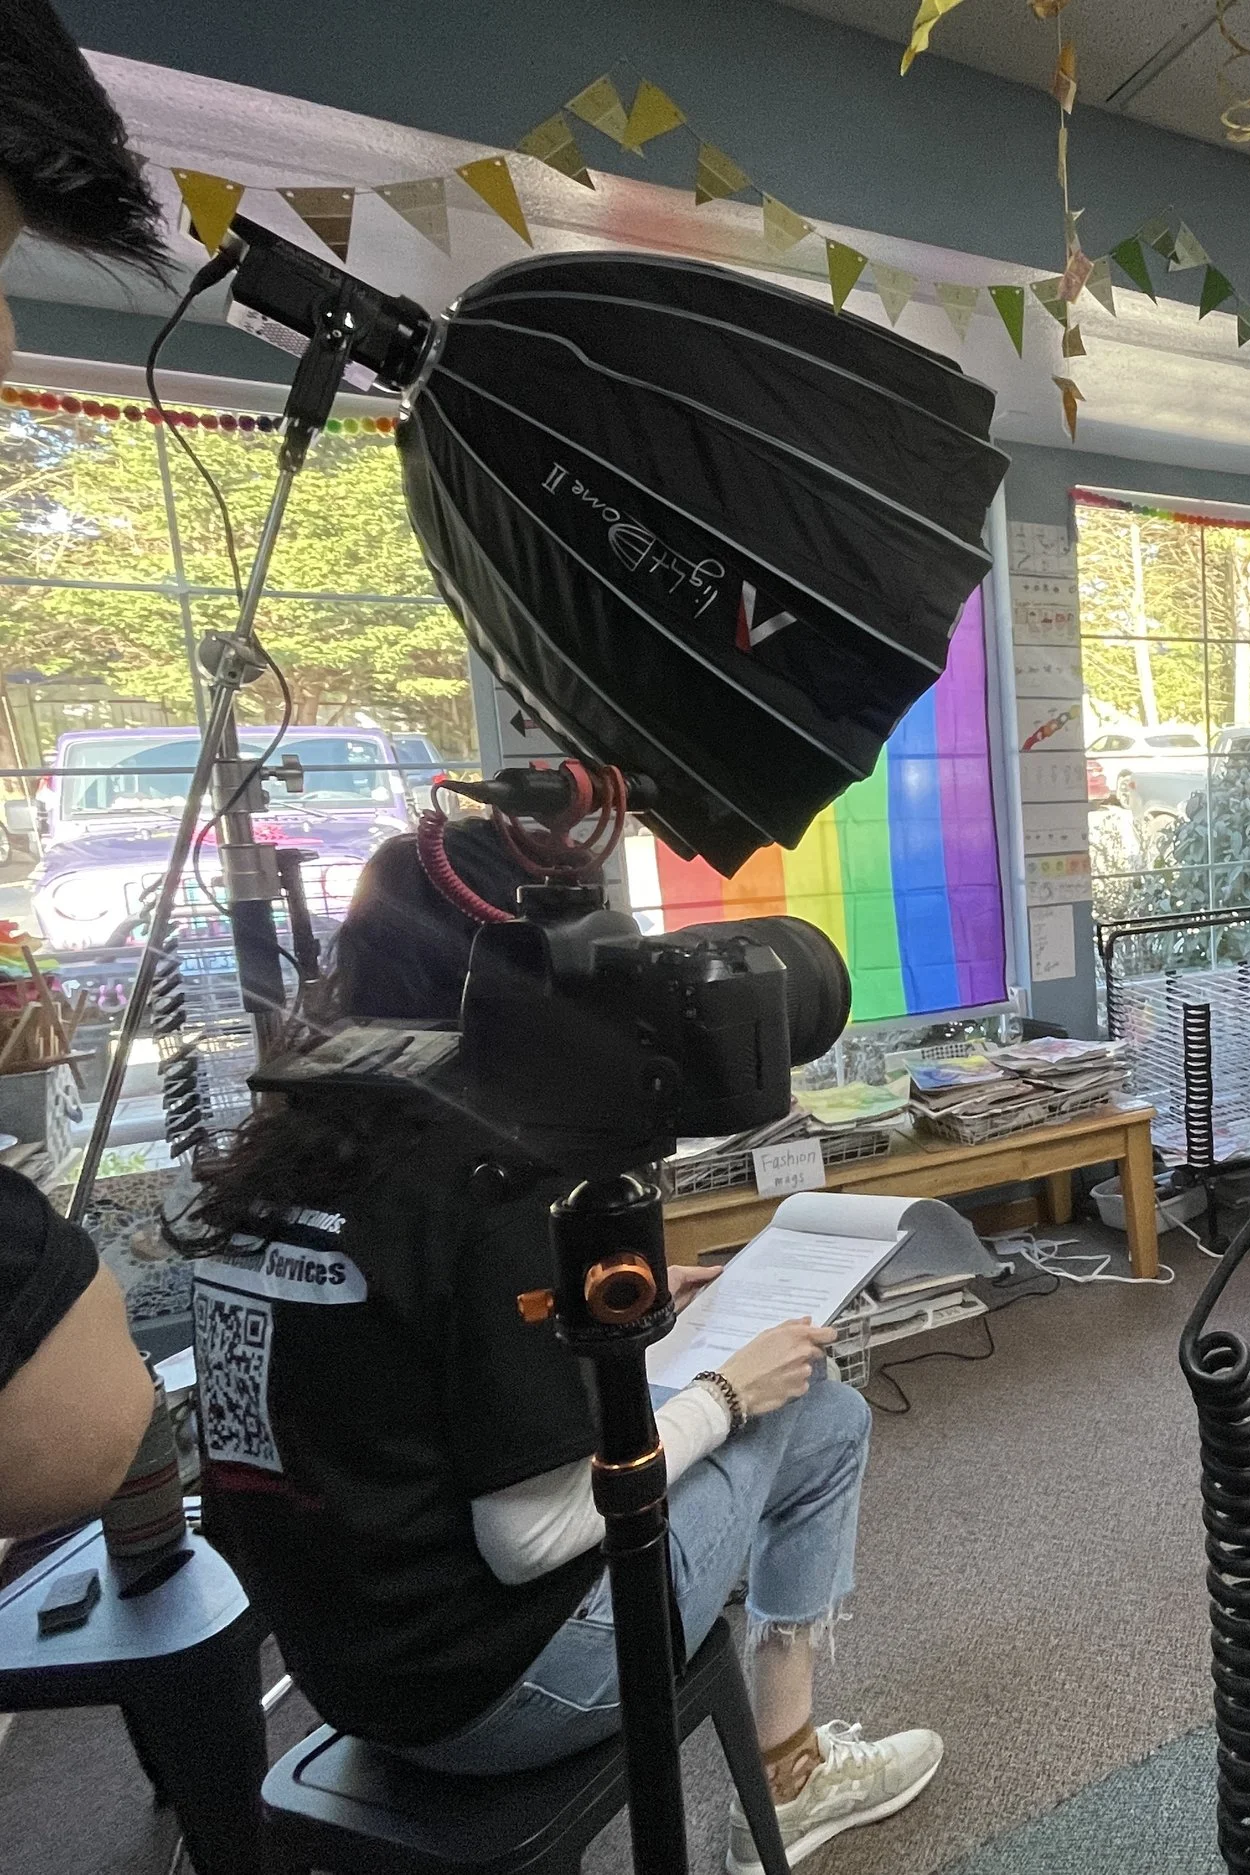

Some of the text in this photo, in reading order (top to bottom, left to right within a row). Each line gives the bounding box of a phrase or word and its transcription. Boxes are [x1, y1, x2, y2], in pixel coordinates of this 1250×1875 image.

[761, 1149, 816, 1172] Fashion
[775, 1173, 805, 1188] mags
[266, 1249, 346, 1285] Services
